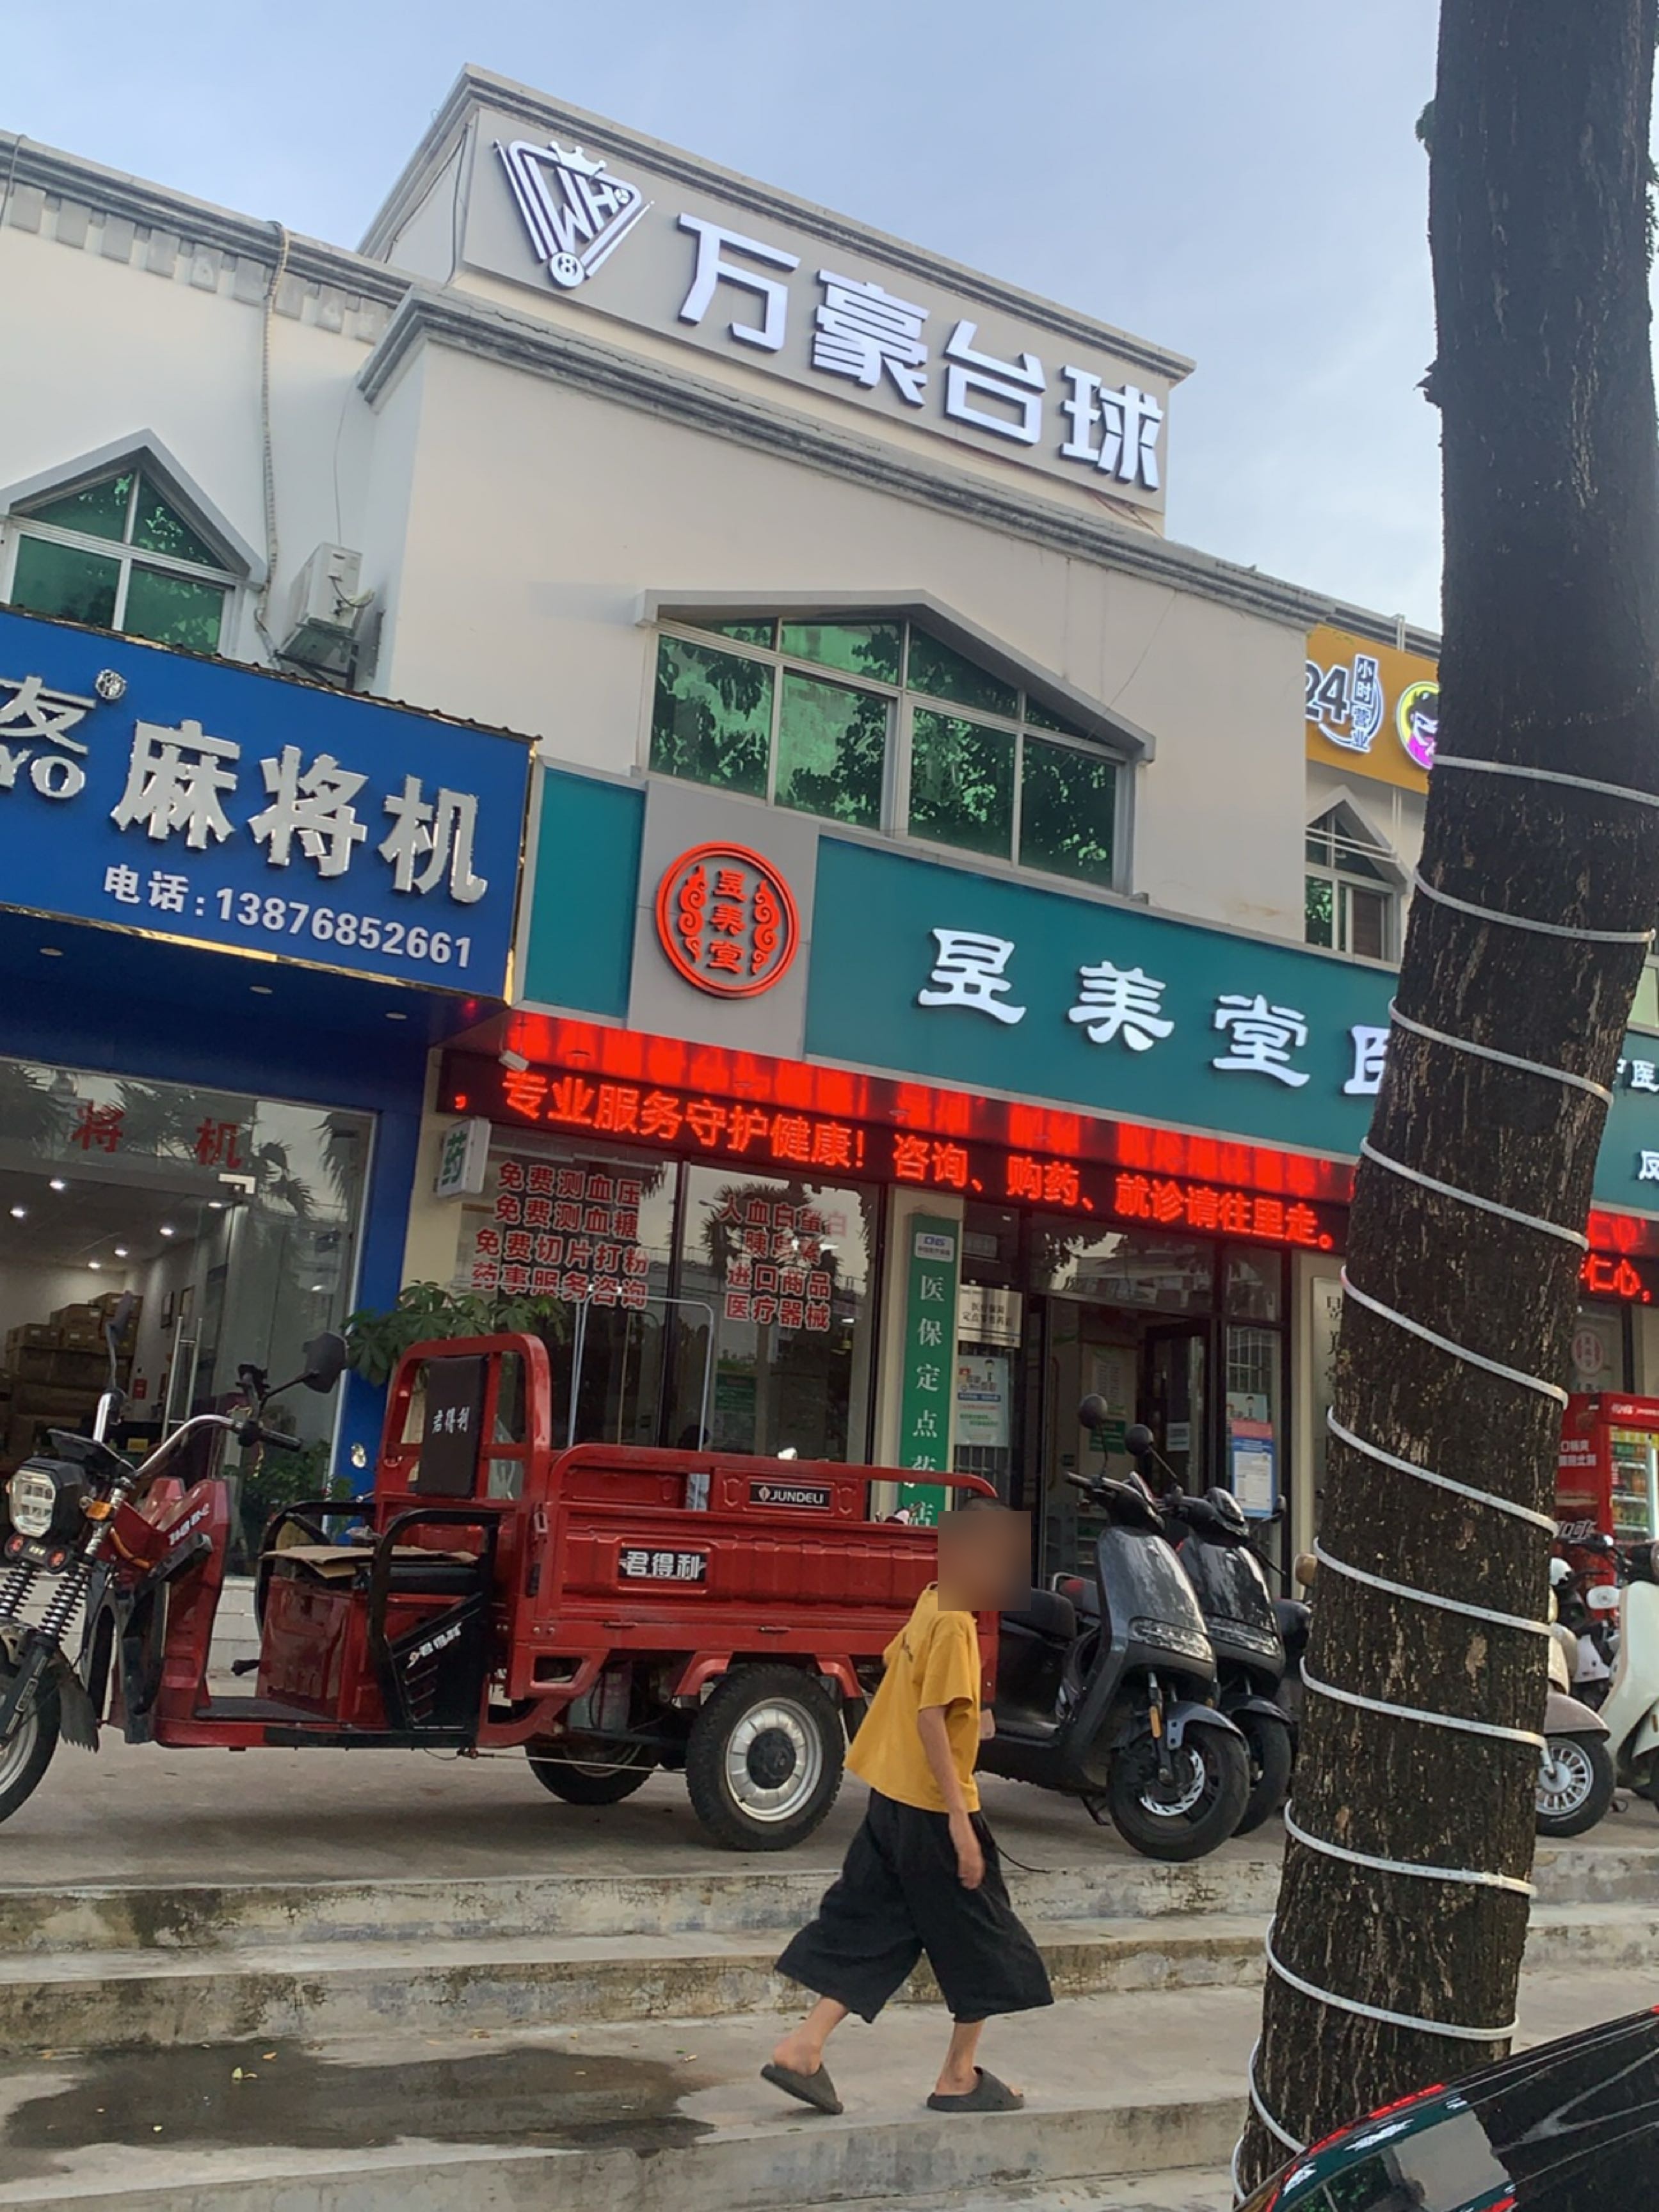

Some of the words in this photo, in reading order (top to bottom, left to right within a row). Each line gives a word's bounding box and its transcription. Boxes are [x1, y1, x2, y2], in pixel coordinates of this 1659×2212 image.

[677, 212, 1164, 492] 万豪台球
[110, 718, 488, 904] 麻将机
[497, 1160, 642, 1208] 免费测血压
[494, 1192, 641, 1240] 免费测血糖
[719, 1194, 847, 1238] 人血白蛋白
[474, 1228, 650, 1276] 免费切片打粉
[724, 1290, 831, 1333] 医疗器械
[770, 1489, 824, 1504] JUNDELI
[626, 1550, 700, 1580] 君得利
